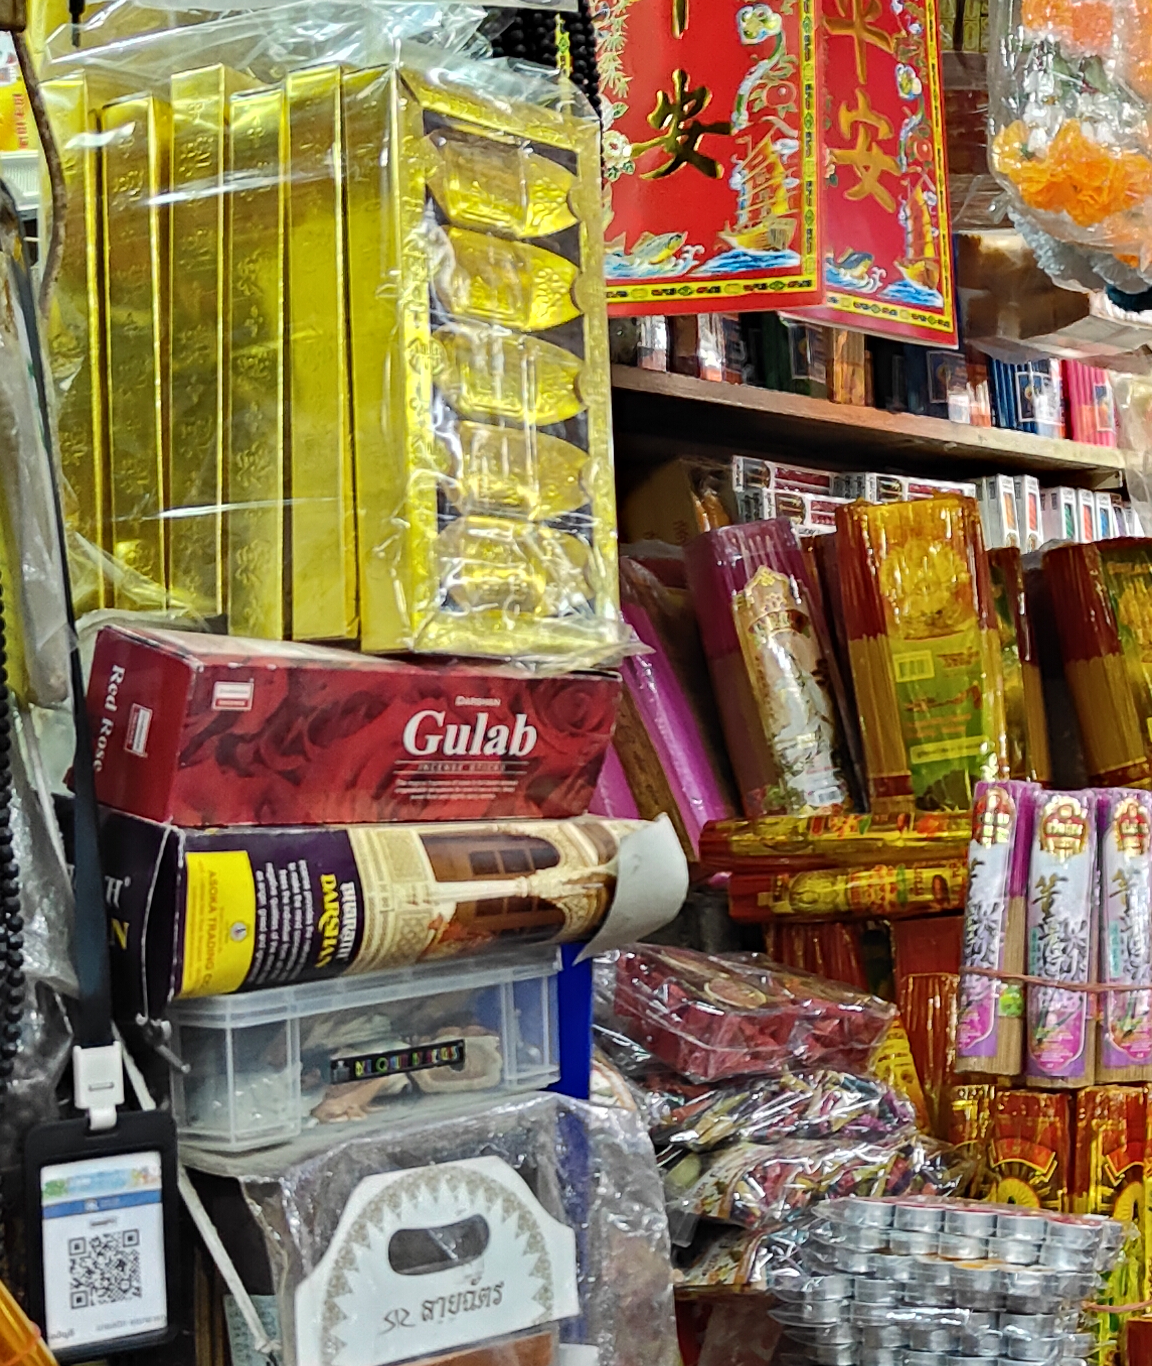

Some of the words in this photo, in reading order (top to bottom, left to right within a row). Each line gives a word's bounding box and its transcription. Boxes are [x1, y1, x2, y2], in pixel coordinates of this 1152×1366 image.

[104, 664, 126, 712] Red
[93, 717, 115, 772] Rose
[403, 709, 537, 756] Gulab
[208, 870, 218, 914] ASOKA
[206, 918, 217, 970] TRADING
[315, 873, 340, 969] DARSHAN
[422, 1275, 504, 1322] สายฉัตร
